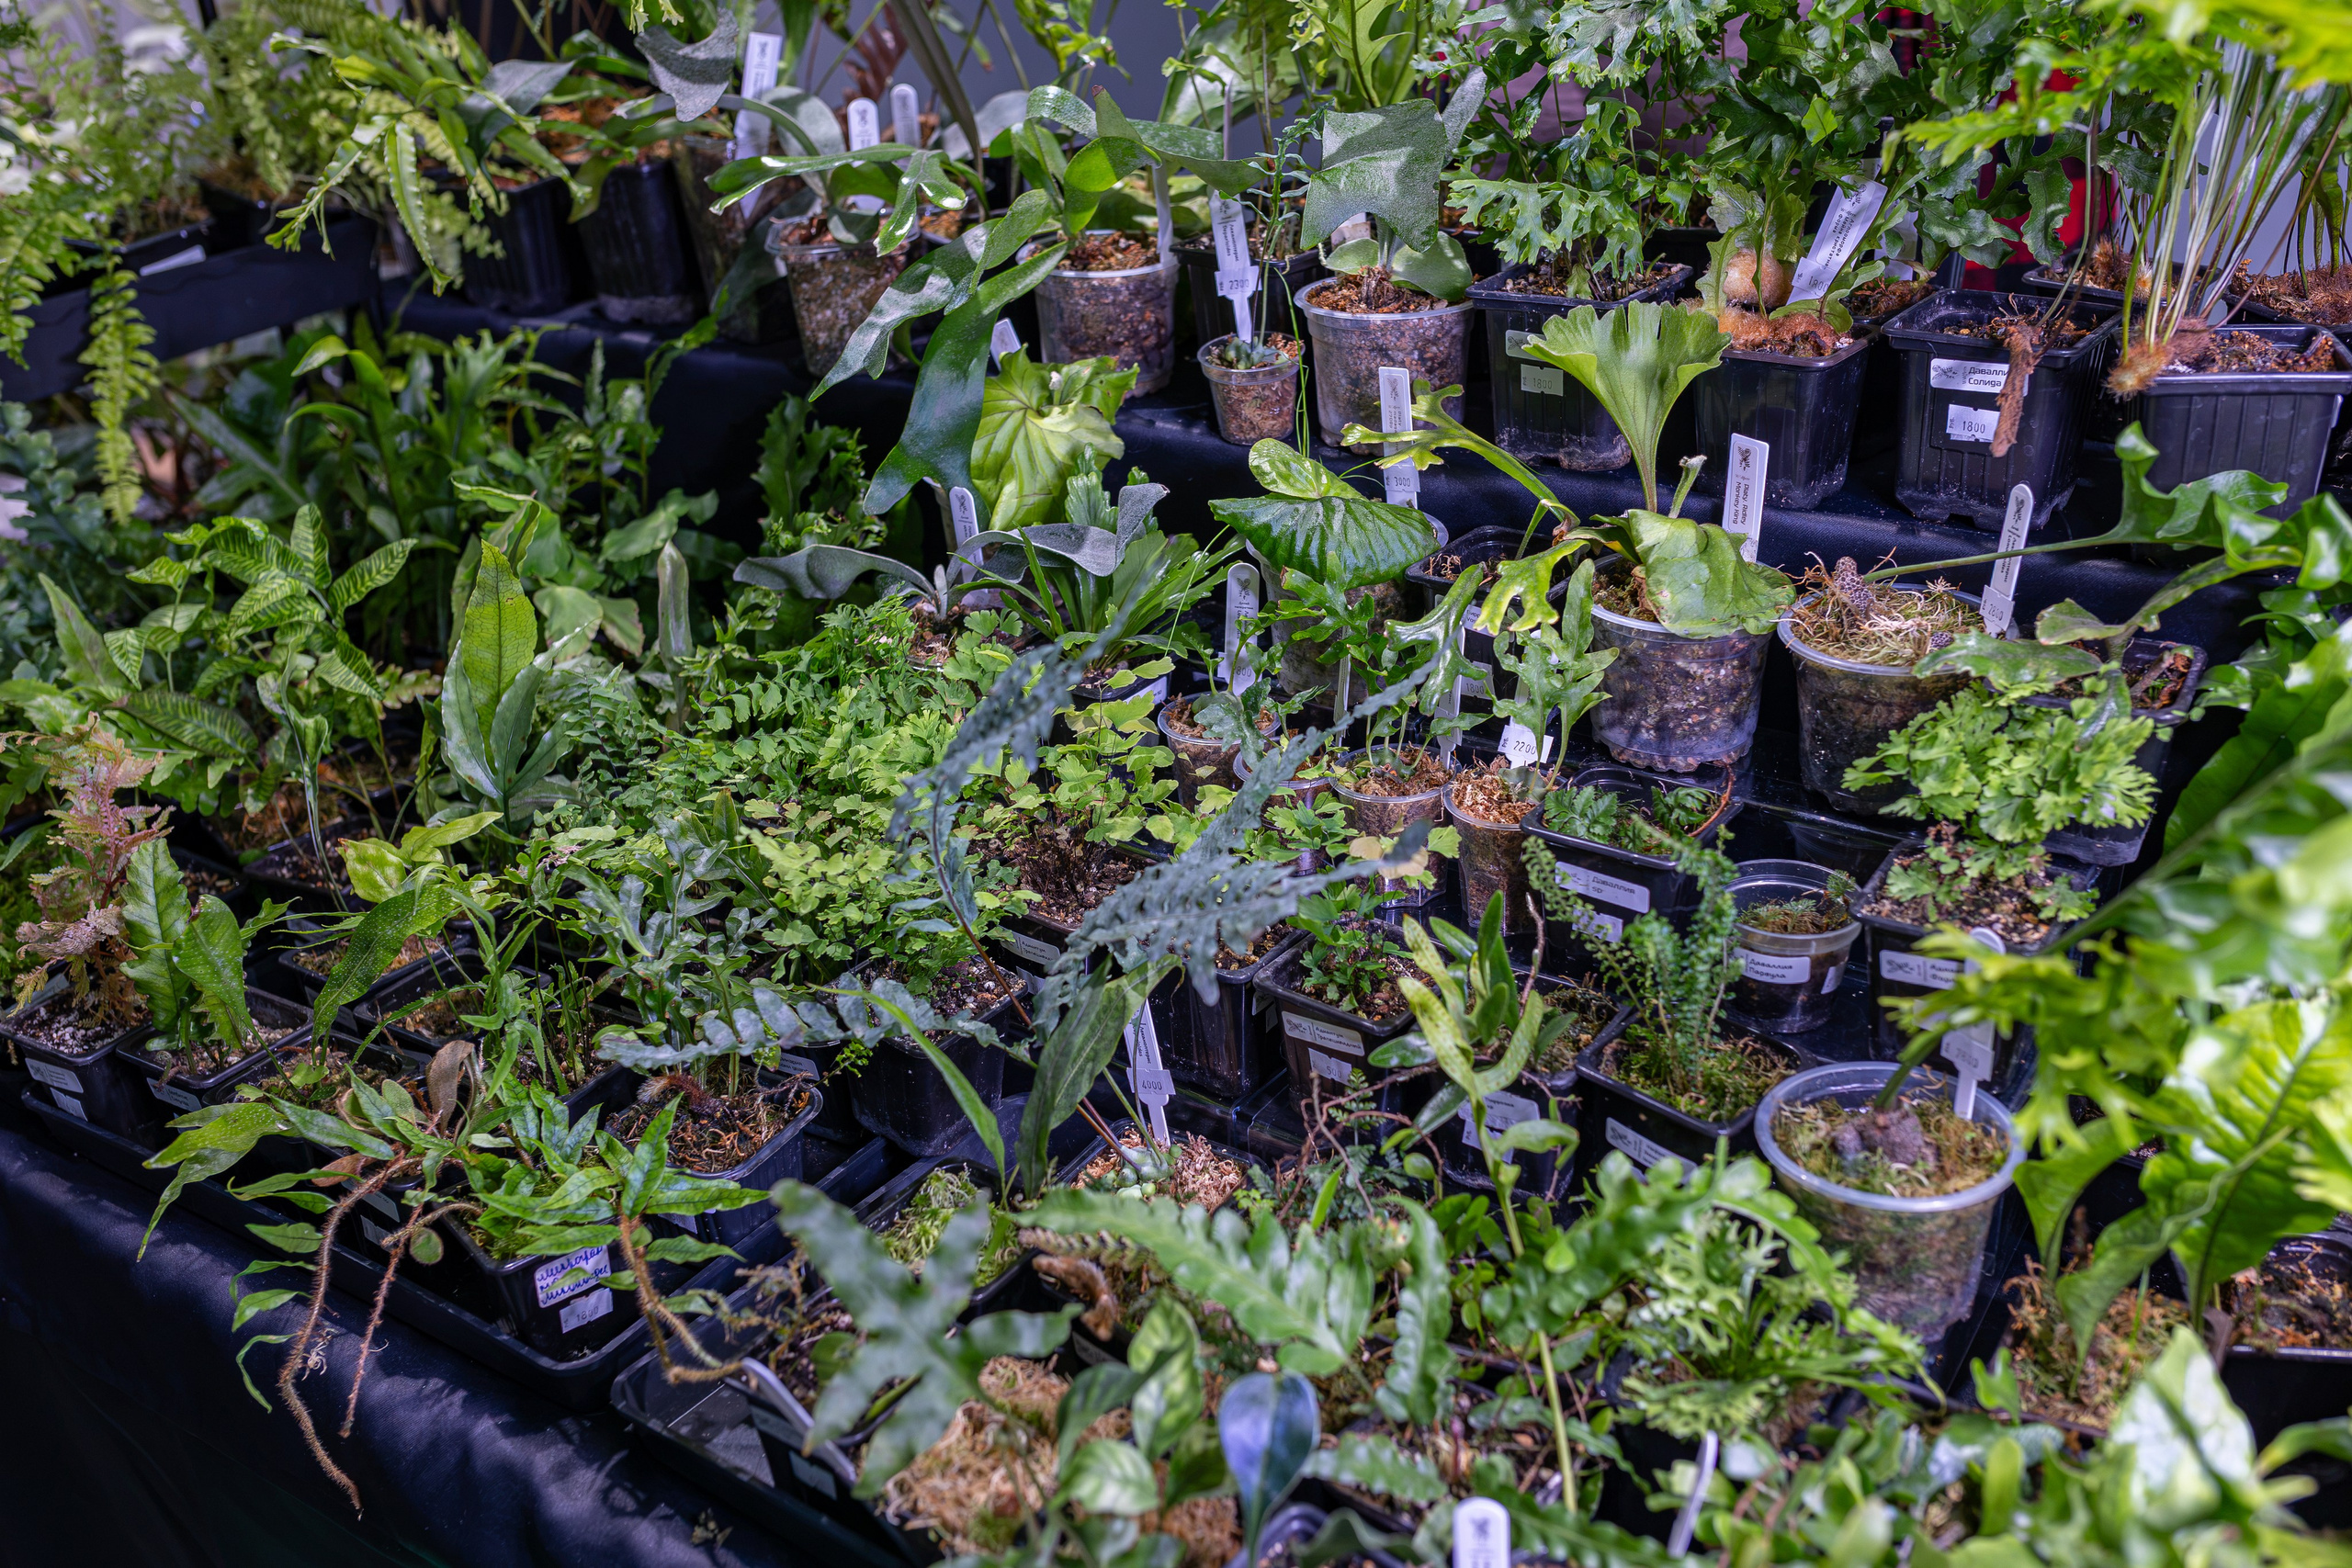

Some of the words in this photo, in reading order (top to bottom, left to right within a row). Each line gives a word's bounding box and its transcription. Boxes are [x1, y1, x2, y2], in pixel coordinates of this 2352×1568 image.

[1228, 278, 1250, 290] 2300
[1968, 367, 2009, 377] Давалли
[1532, 377, 1553, 389] 1800
[1968, 378, 2001, 388] Солида
[1962, 421, 1986, 434] 1800
[1394, 476, 1411, 487] 3000
[1733, 481, 1742, 509] Monkey
[1740, 503, 1748, 525] Ridley
[1237, 665, 1251, 678] 800
[1465, 682, 1485, 694] 1800
[1513, 740, 1537, 755] 2200
[1748, 957, 1793, 970] Даваллия
[1749, 966, 1786, 979] Парвула
[1141, 1080, 1163, 1091] 4000
[576, 1305, 599, 1323] 1800
